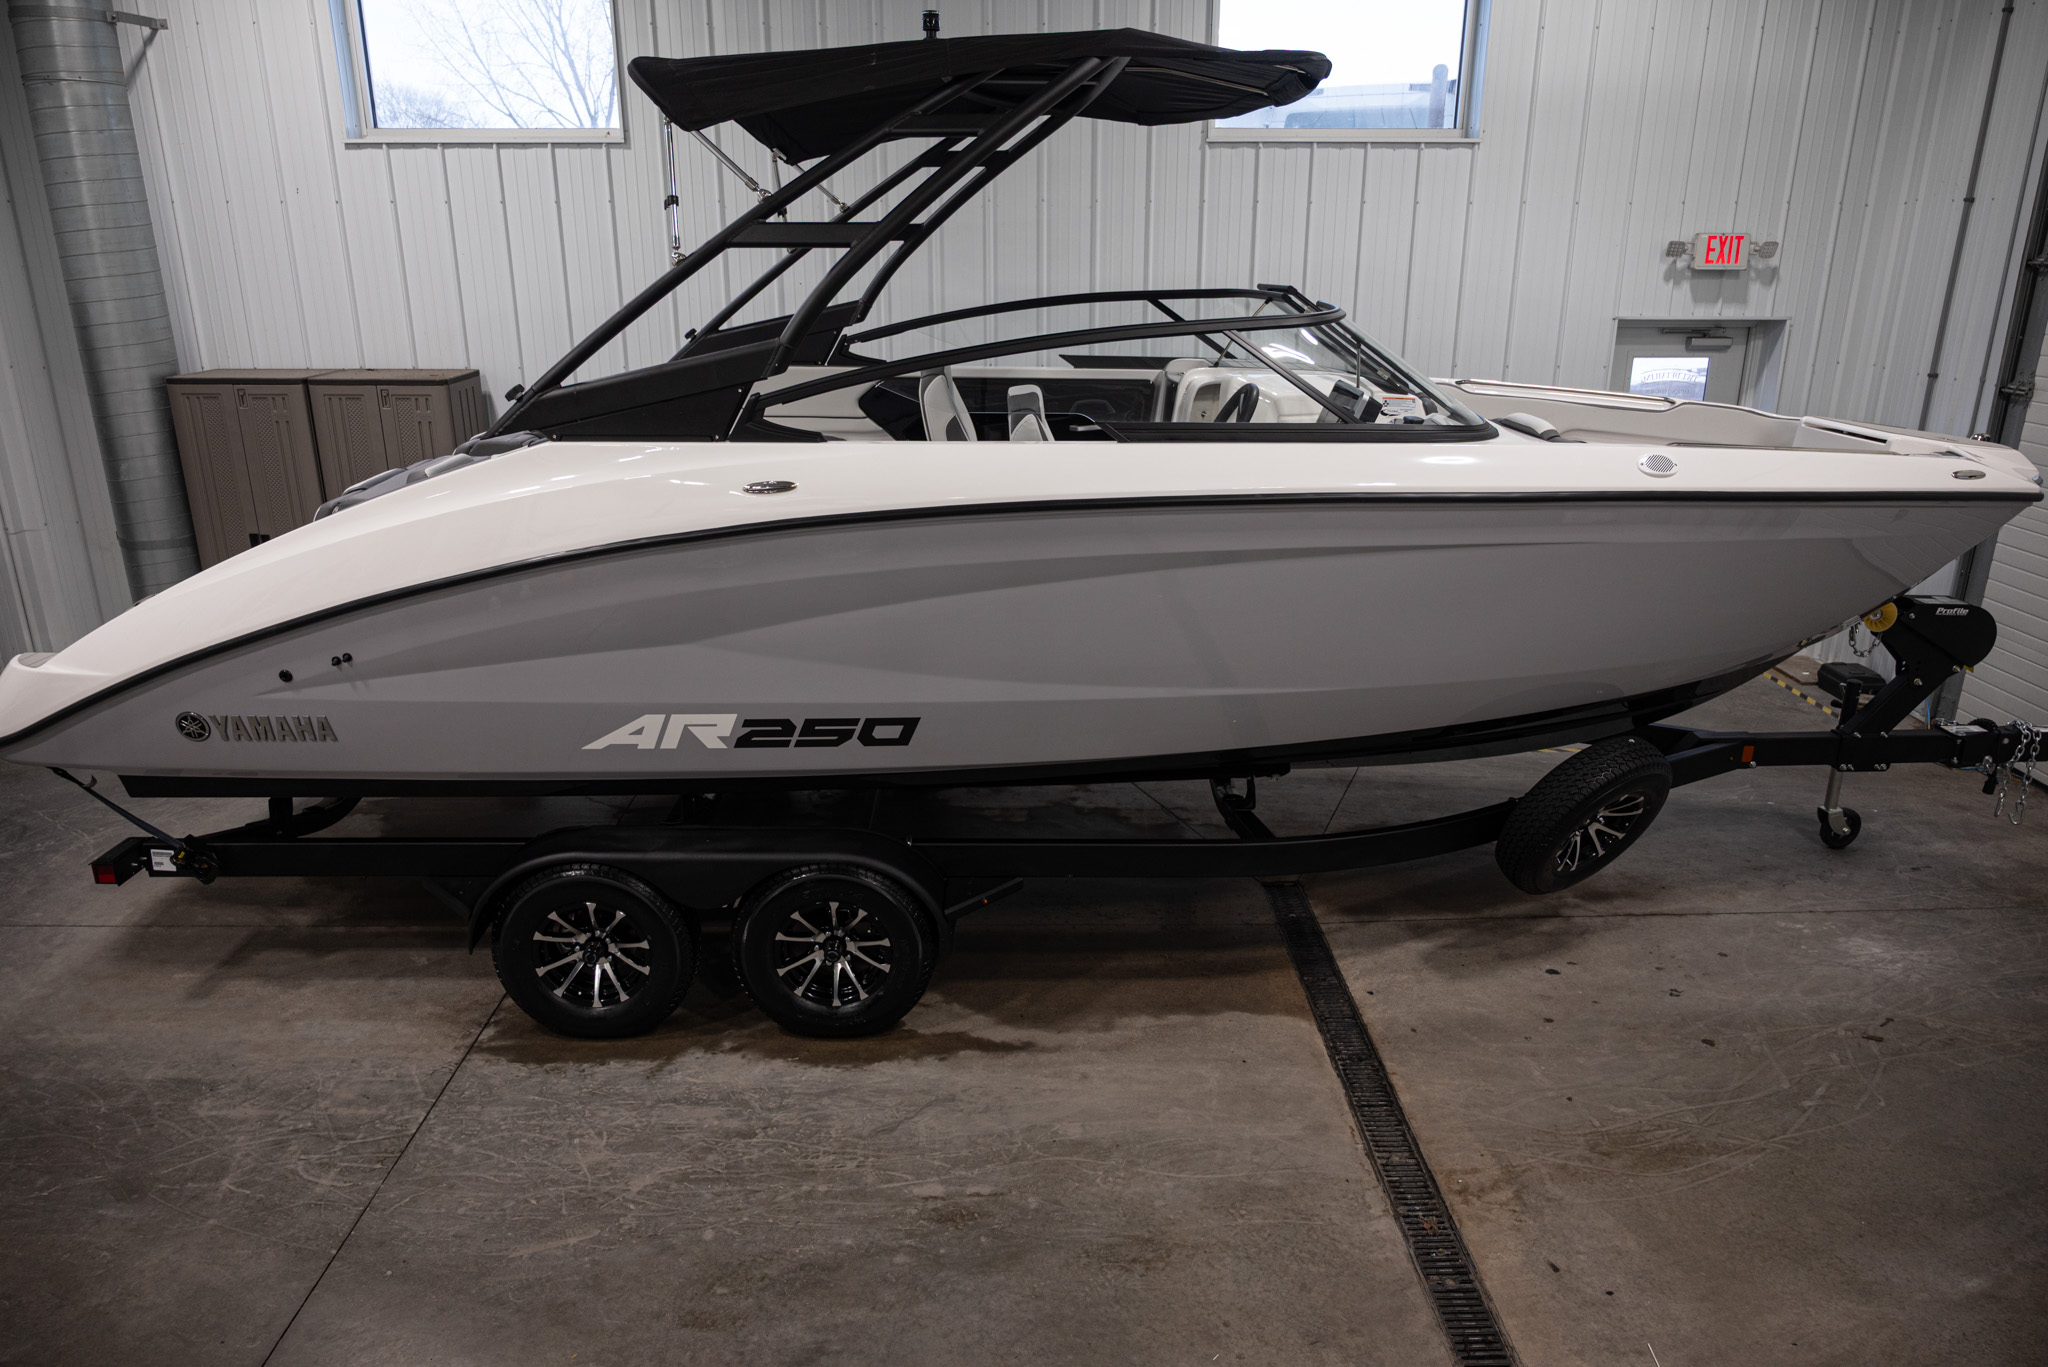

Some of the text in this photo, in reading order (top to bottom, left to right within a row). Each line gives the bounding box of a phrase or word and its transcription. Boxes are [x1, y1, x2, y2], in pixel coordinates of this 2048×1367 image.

[1705, 235, 1744, 264] EXIT
[1935, 607, 1969, 615] Profile
[208, 714, 339, 742] YAMAHA
[581, 713, 922, 750] AR250
